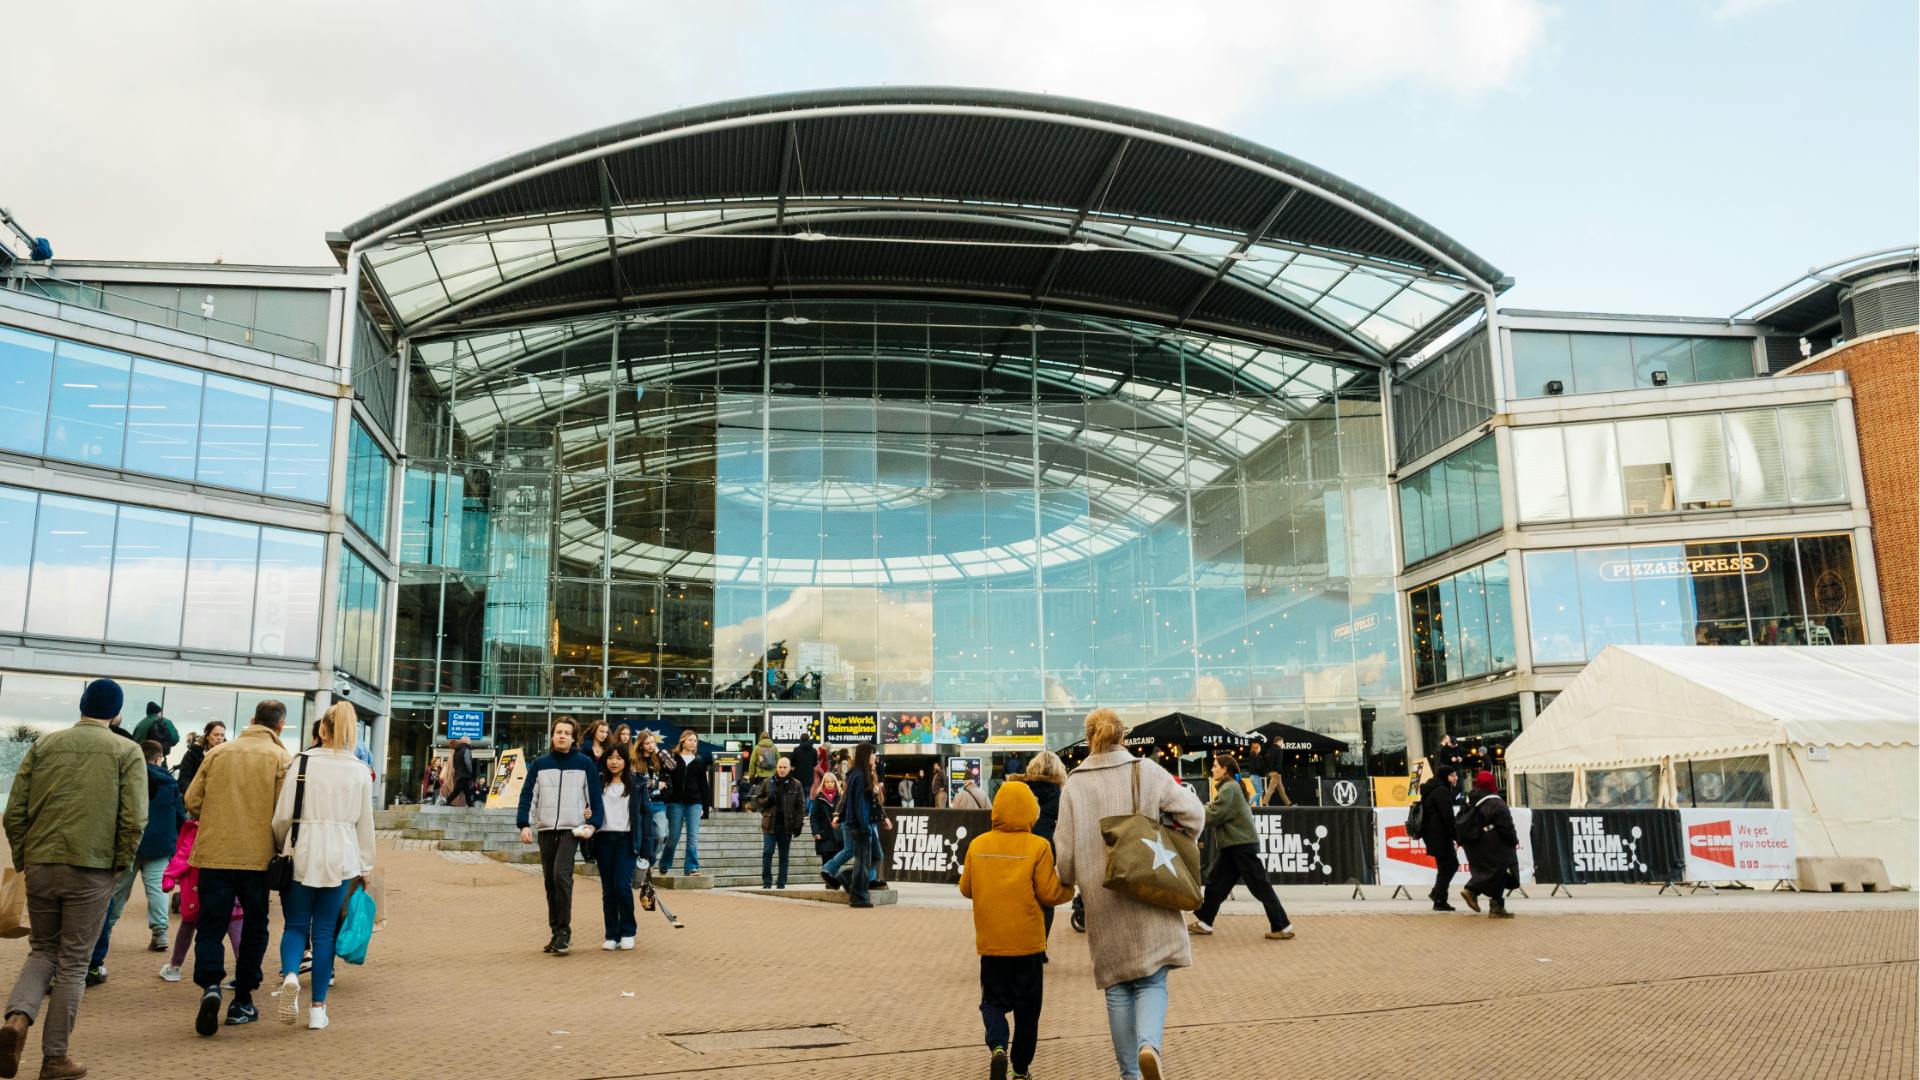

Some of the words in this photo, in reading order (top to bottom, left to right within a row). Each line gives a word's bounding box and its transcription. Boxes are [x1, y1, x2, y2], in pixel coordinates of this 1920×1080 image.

[772, 715, 813, 724] NORWICH
[772, 723, 808, 732] SCIENCE
[828, 716, 848, 724] Your
[848, 716, 875, 725] World,
[828, 724, 876, 735] Reimagined
[1202, 735, 1223, 744] CAFE
[1226, 736, 1231, 744] &
[1234, 737, 1250, 746] BAR
[1281, 742, 1312, 750] ARZANO
[896, 815, 929, 834] THE
[1253, 814, 1283, 834] HE
[1569, 816, 1605, 835] THE
[1737, 825, 1752, 835] We
[1753, 827, 1769, 838] get
[893, 833, 943, 853] ATOM
[1258, 834, 1303, 853] TOM
[1572, 834, 1623, 853] ATOM
[1739, 840, 1754, 850] you
[1756, 838, 1790, 849] noticed.
[892, 852, 948, 872] STAGE
[1256, 853, 1310, 872] TAGE
[1573, 852, 1629, 872] STAGE
